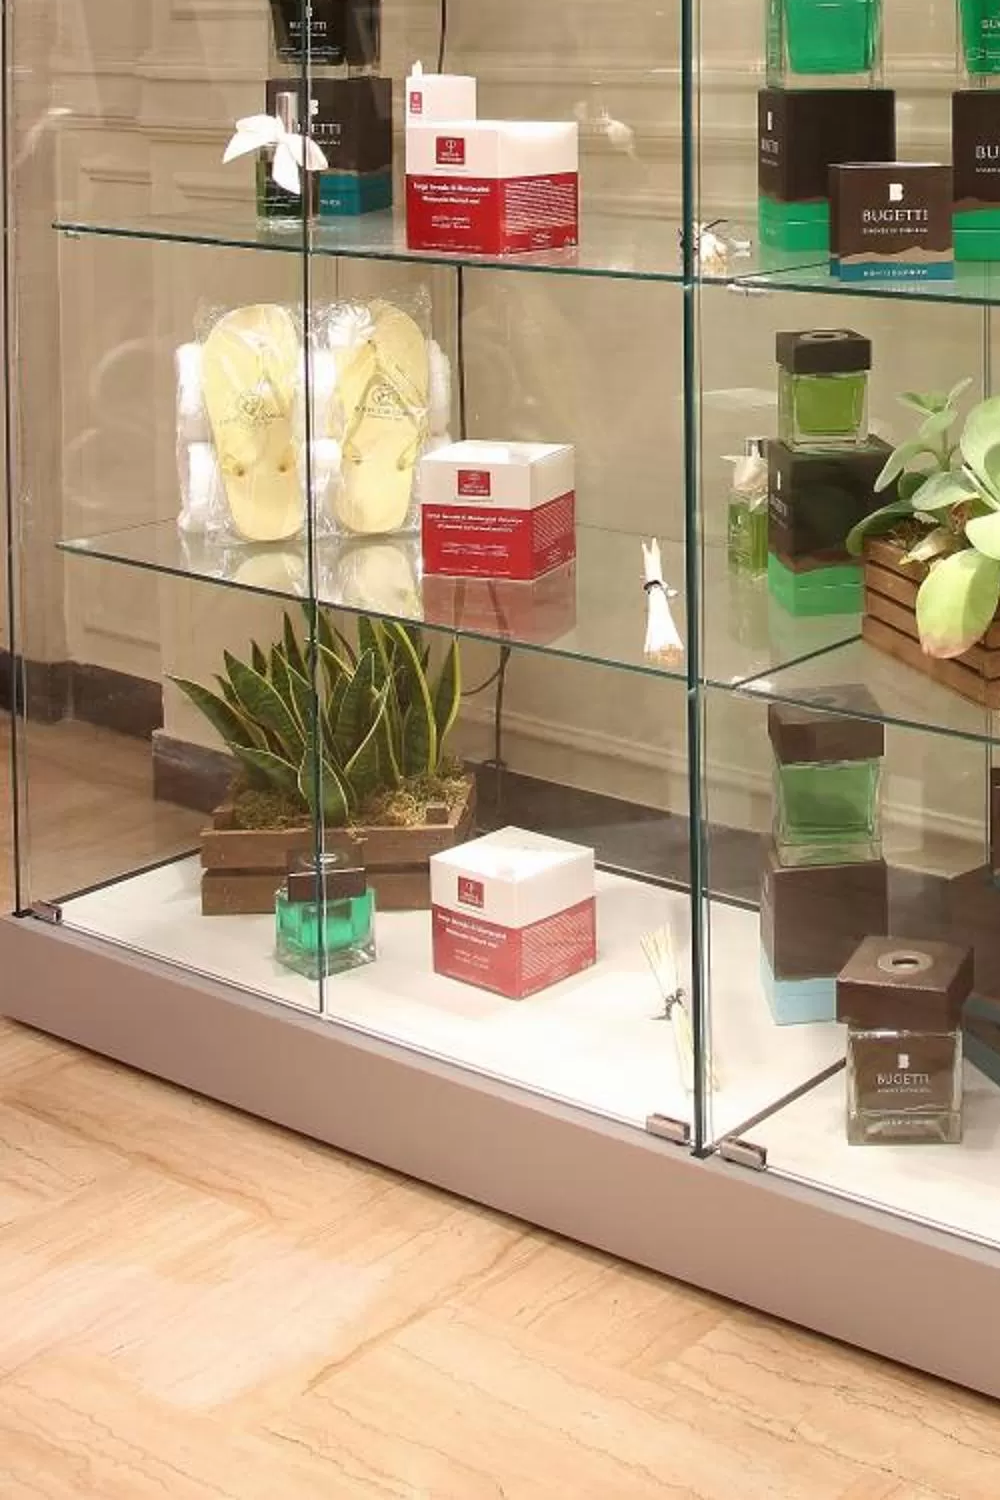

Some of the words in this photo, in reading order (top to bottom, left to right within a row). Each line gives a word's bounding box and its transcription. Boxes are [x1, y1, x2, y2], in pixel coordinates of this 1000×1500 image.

[889, 183, 905, 202] B
[862, 208, 929, 223] BUGETTI
[876, 1073, 930, 1085] BUGETTI
